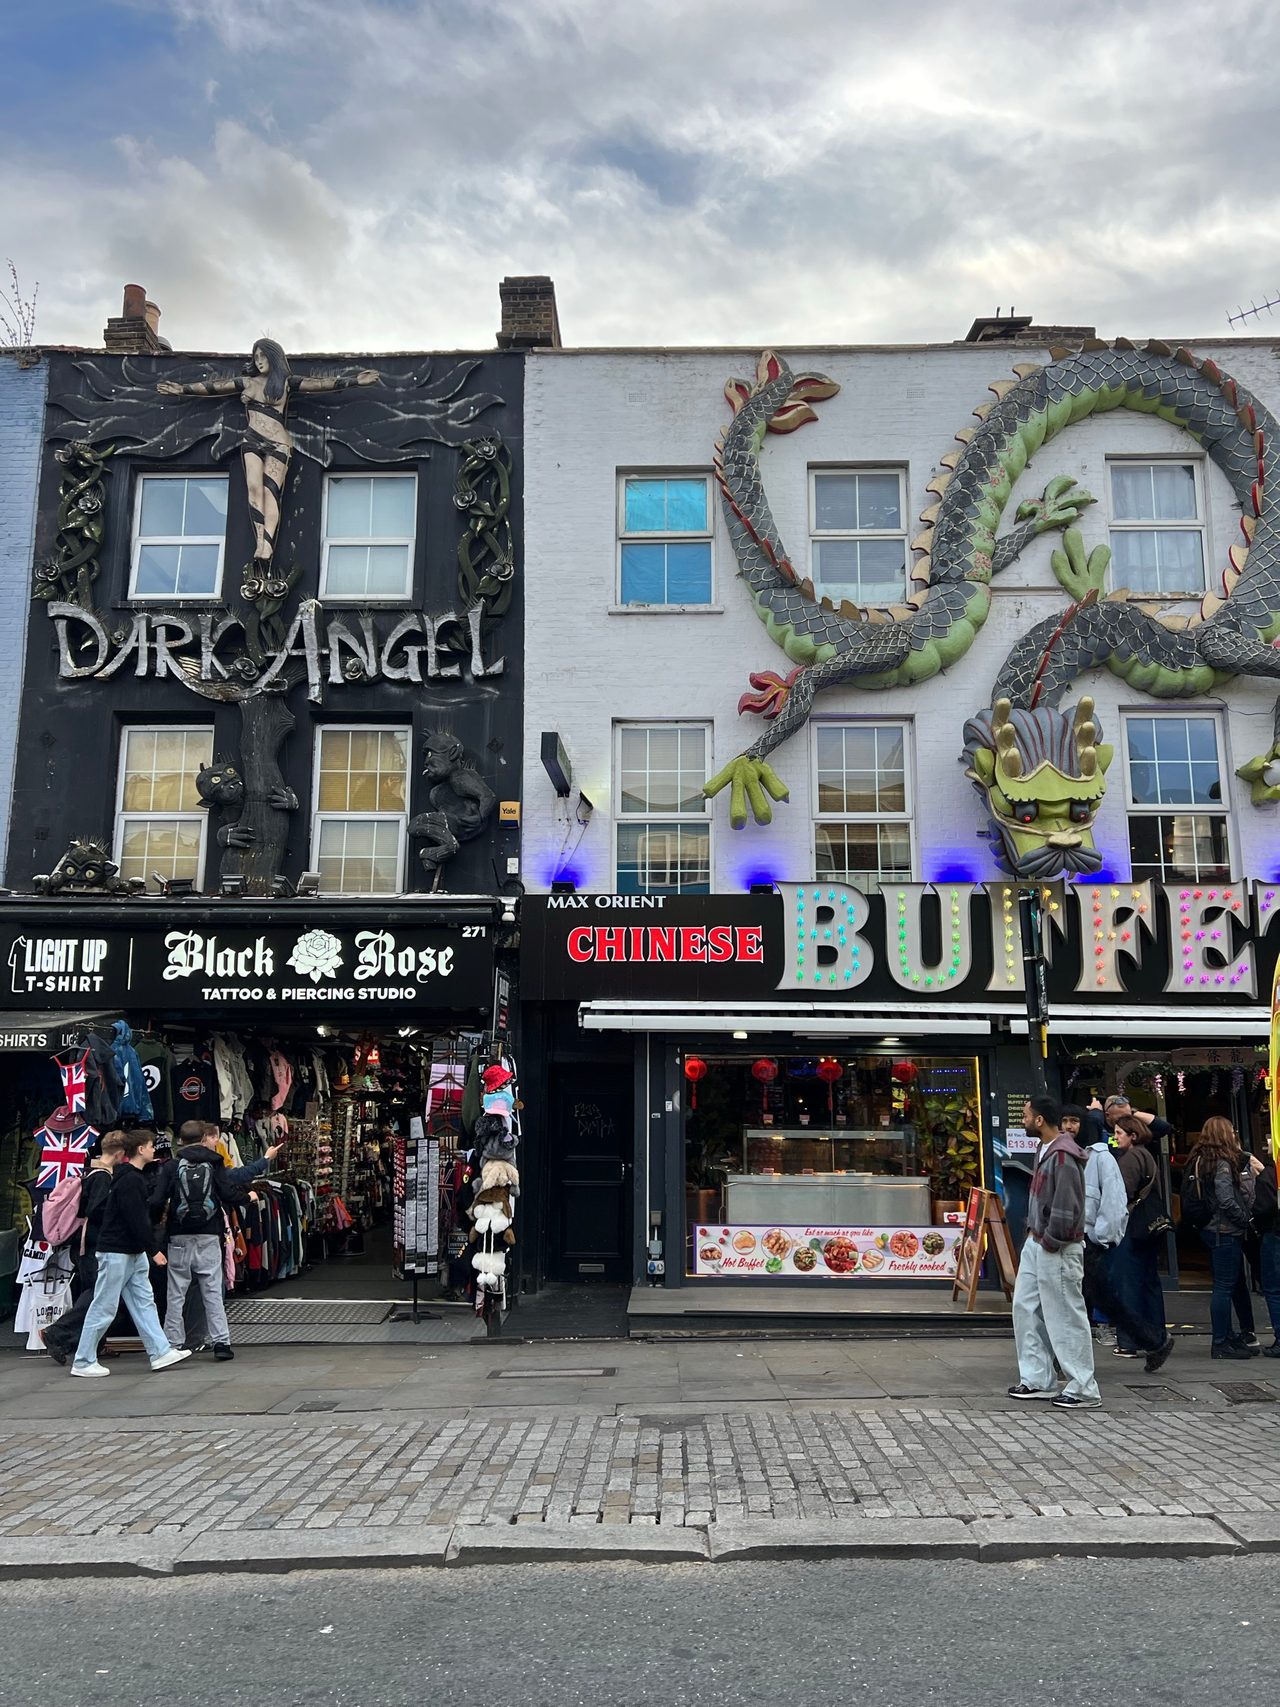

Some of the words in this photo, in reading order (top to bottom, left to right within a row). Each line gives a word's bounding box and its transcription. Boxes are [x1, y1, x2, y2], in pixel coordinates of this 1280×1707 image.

[48, 601, 262, 701] DARK
[255, 597, 507, 704] ANGEL
[502, 807, 516, 815] Yale
[547, 895, 589, 909] MAX
[595, 895, 667, 909] ORIENT
[462, 926, 486, 938] 271
[567, 925, 764, 964] CHINESE
[774, 880, 1280, 999] BUFFE
[24, 938, 78, 973] LIGHT
[82, 938, 108, 972] UP
[162, 930, 275, 981] Black
[353, 929, 455, 984] Rose
[25, 975, 104, 992] T-SHIRT
[201, 987, 264, 1000] TATTOO
[266, 988, 277, 1000] &
[281, 987, 355, 1000] PIERCING
[357, 987, 417, 1000] STUDIO
[721, 1257, 737, 1268] Hot
[737, 1257, 765, 1271] Buffet
[888, 1260, 918, 1273] Freshly
[919, 1261, 947, 1271] cooked
